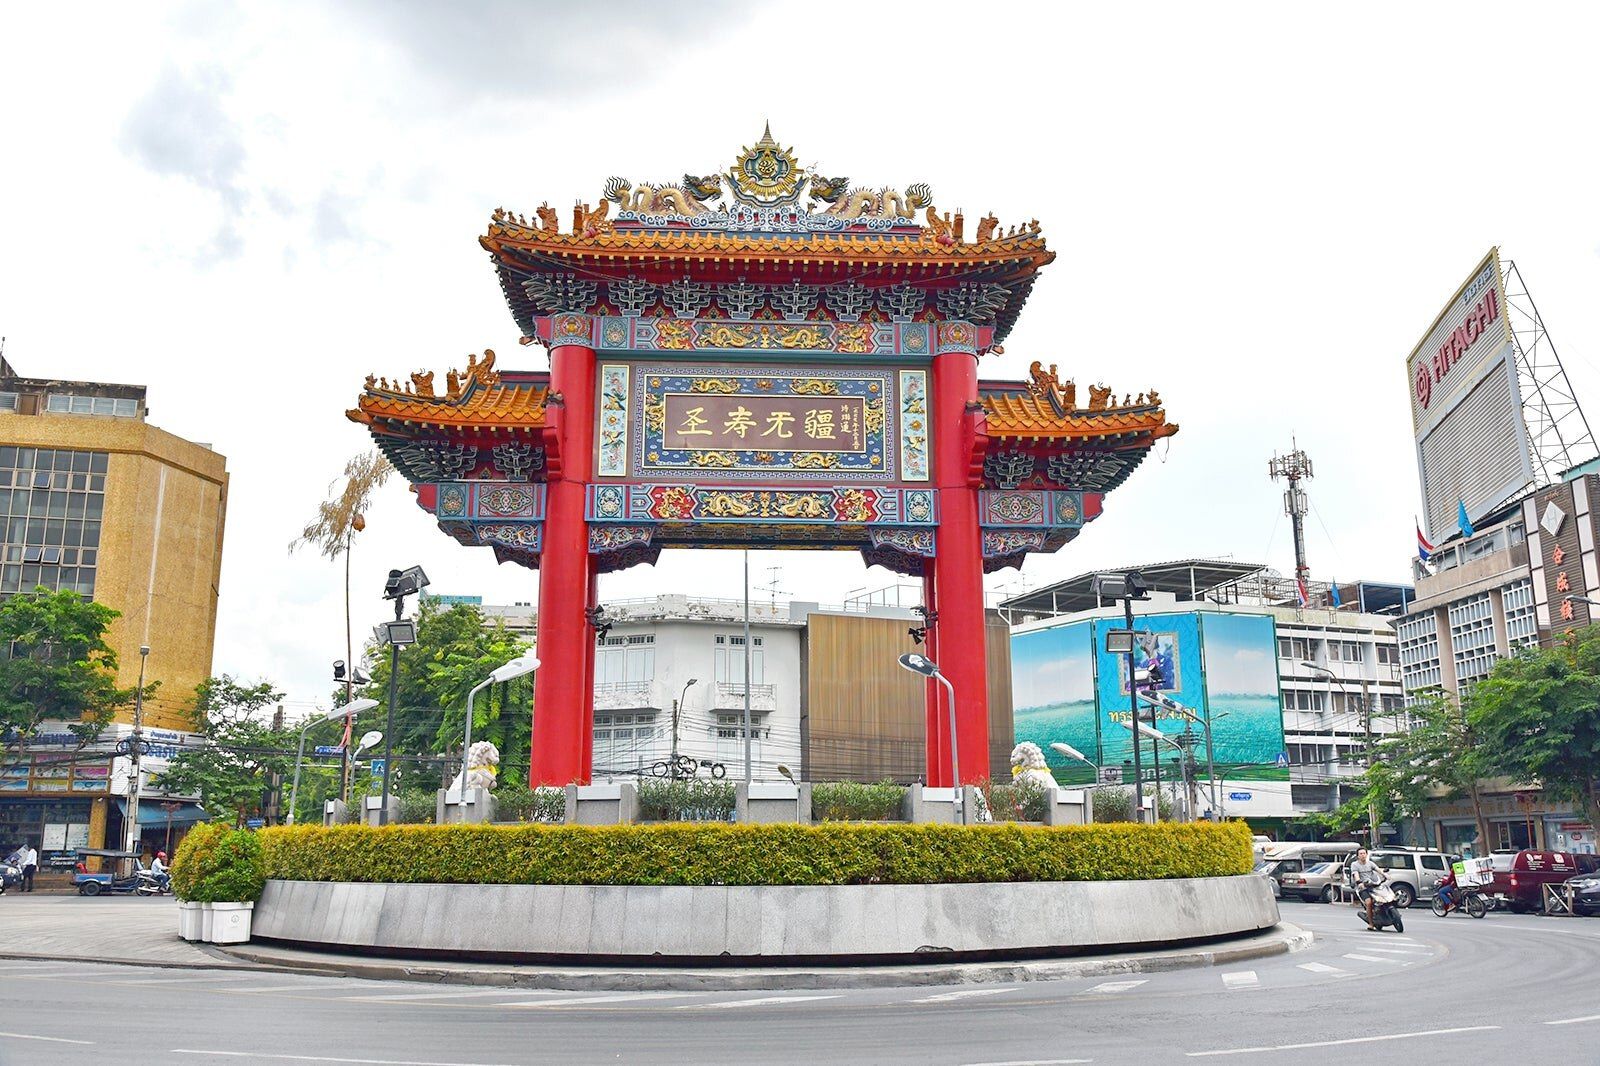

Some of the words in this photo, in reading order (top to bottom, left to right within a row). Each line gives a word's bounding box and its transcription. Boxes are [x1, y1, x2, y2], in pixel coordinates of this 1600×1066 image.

[1432, 288, 1498, 383] HITACHI
[676, 405, 836, 440] 圣寿无疆
